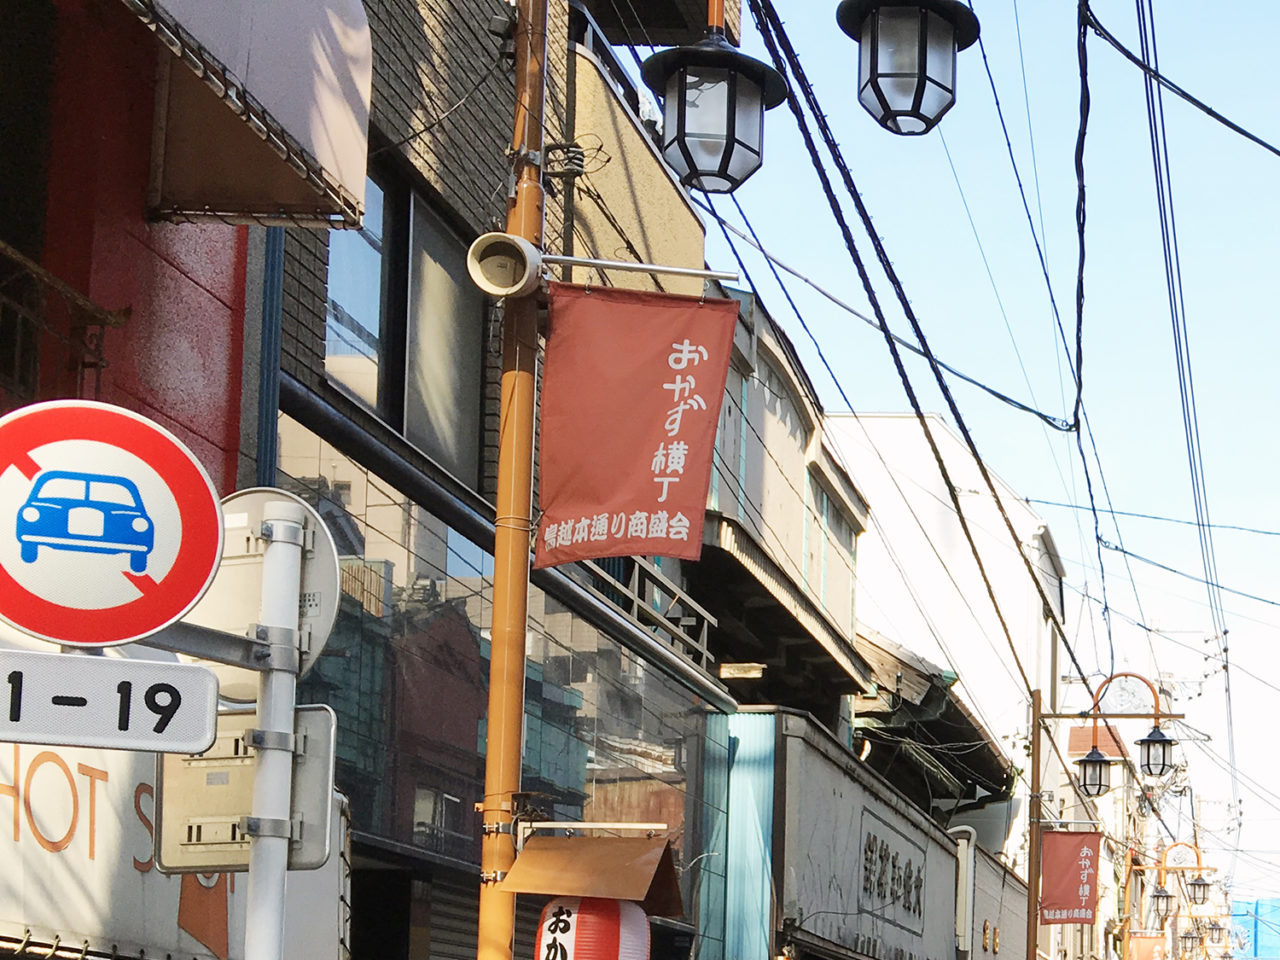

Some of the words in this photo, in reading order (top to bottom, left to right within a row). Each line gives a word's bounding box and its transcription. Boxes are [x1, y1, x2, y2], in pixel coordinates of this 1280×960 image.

[651, 339, 708, 502] おかず横丁
[543, 511, 691, 552] 鳥越本通り商盛会
[1078, 845, 1094, 906] おかず横丁
